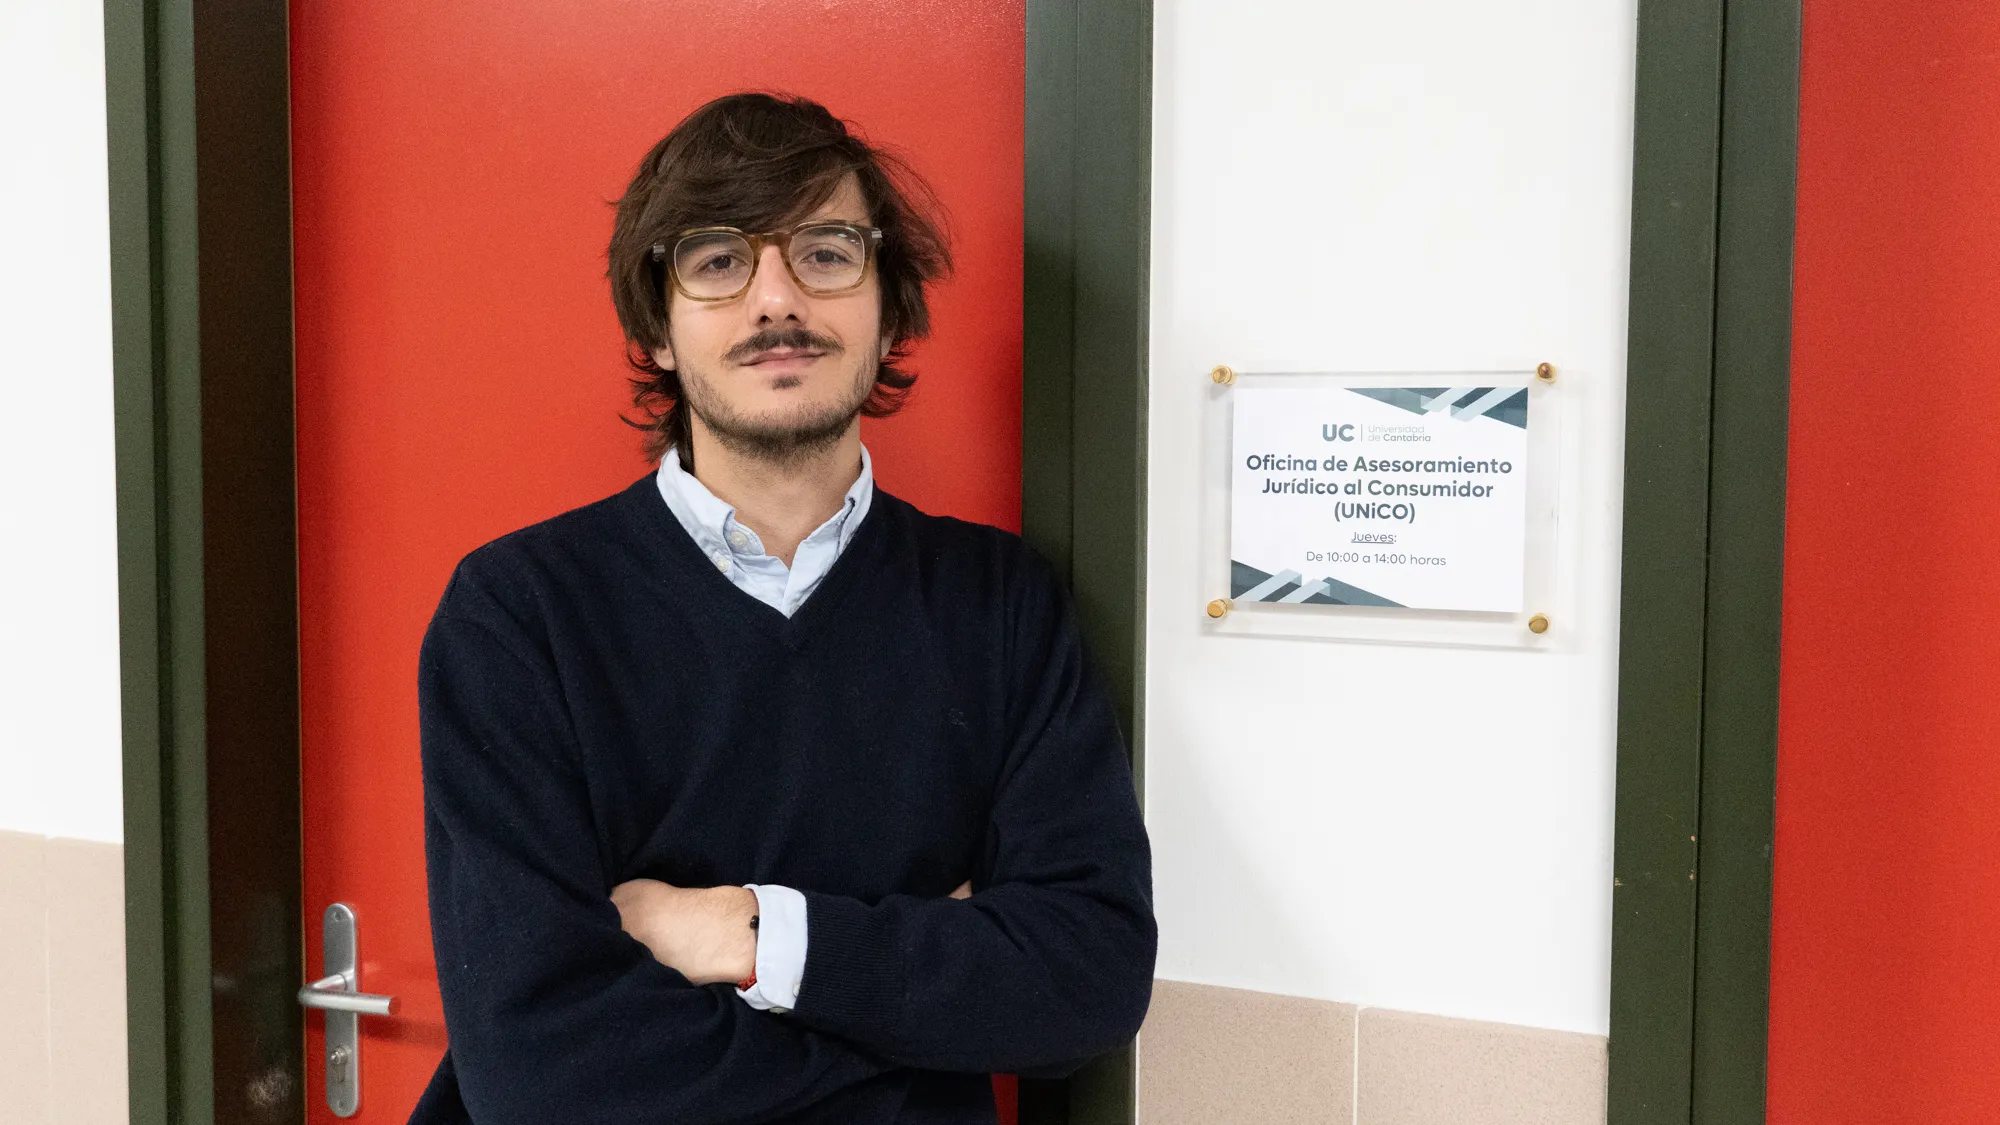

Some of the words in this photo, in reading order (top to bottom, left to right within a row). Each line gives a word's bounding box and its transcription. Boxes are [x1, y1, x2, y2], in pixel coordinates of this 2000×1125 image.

[1323, 424, 1355, 442] UC
[1368, 425, 1425, 433] Universidad
[1368, 433, 1381, 442] de
[1383, 433, 1431, 442] Cantabria
[1247, 454, 1317, 471] Oficina
[1323, 455, 1348, 471] de
[1353, 456, 1512, 473] Asesoramiento
[1262, 478, 1338, 495] Jurídico
[1344, 479, 1361, 495] al
[1368, 480, 1493, 497] Consumidor
[1335, 502, 1415, 524] (UNiCO)
[1350, 531, 1397, 544] Jueves:
[1306, 551, 1323, 562] De
[1327, 552, 1359, 563] 10:00
[1362, 555, 1371, 564] a
[1374, 553, 1407, 565] 14:00
[1410, 554, 1447, 566] horas
